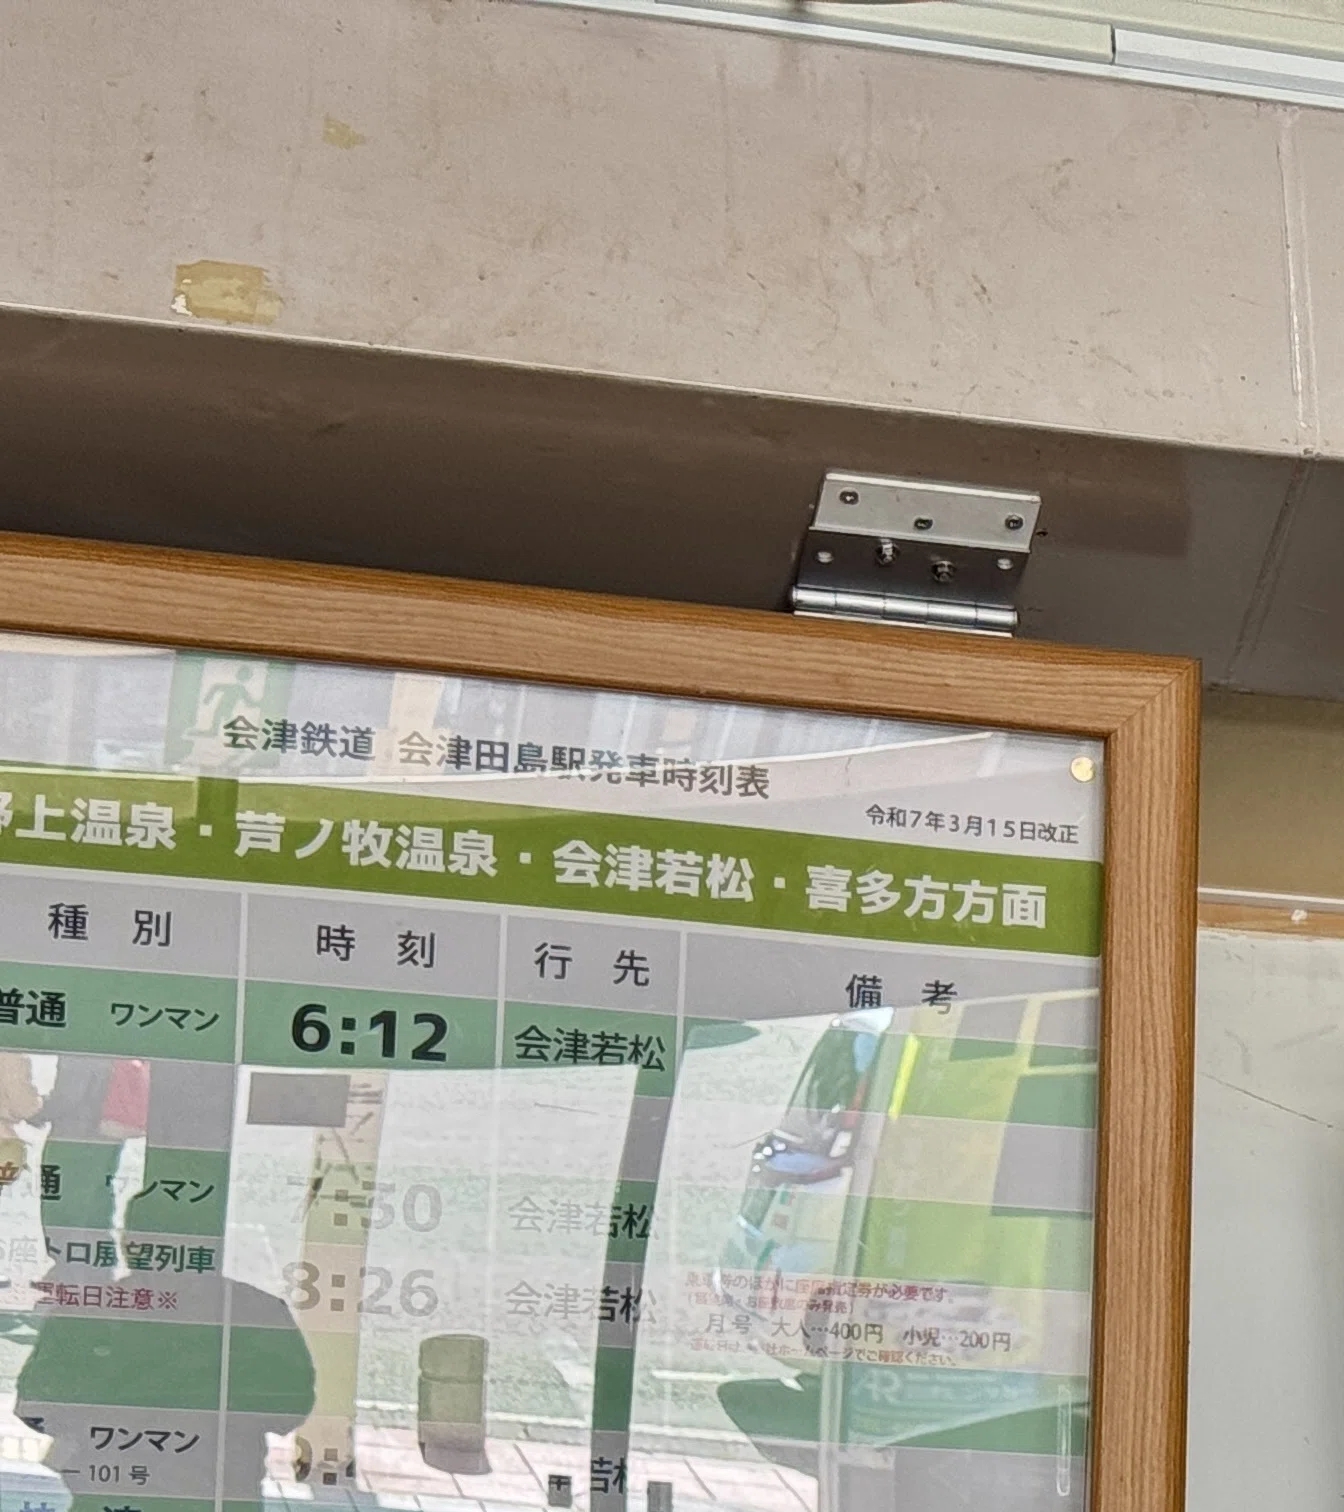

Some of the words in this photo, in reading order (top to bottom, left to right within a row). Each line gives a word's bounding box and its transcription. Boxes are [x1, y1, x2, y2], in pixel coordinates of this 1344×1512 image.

[222, 715, 376, 761] 会津鉄道
[398, 730, 770, 800] 会津田島駅発車時刻表
[865, 804, 1079, 846] 令和7年3月15日改正
[0, 791, 1047, 930] 上温泉・芦ノ牧温泉・会津若松・喜多方方面
[110, 1002, 220, 1032] ワンマン
[291, 1004, 448, 1063] 6:12
[514, 1024, 667, 1072] 会津若松
[508, 1195, 660, 1241] 会津若松
[282, 1261, 439, 1318] 8:26
[504, 1280, 657, 1325] 会津若松
[90, 1426, 200, 1453] ワンマン
